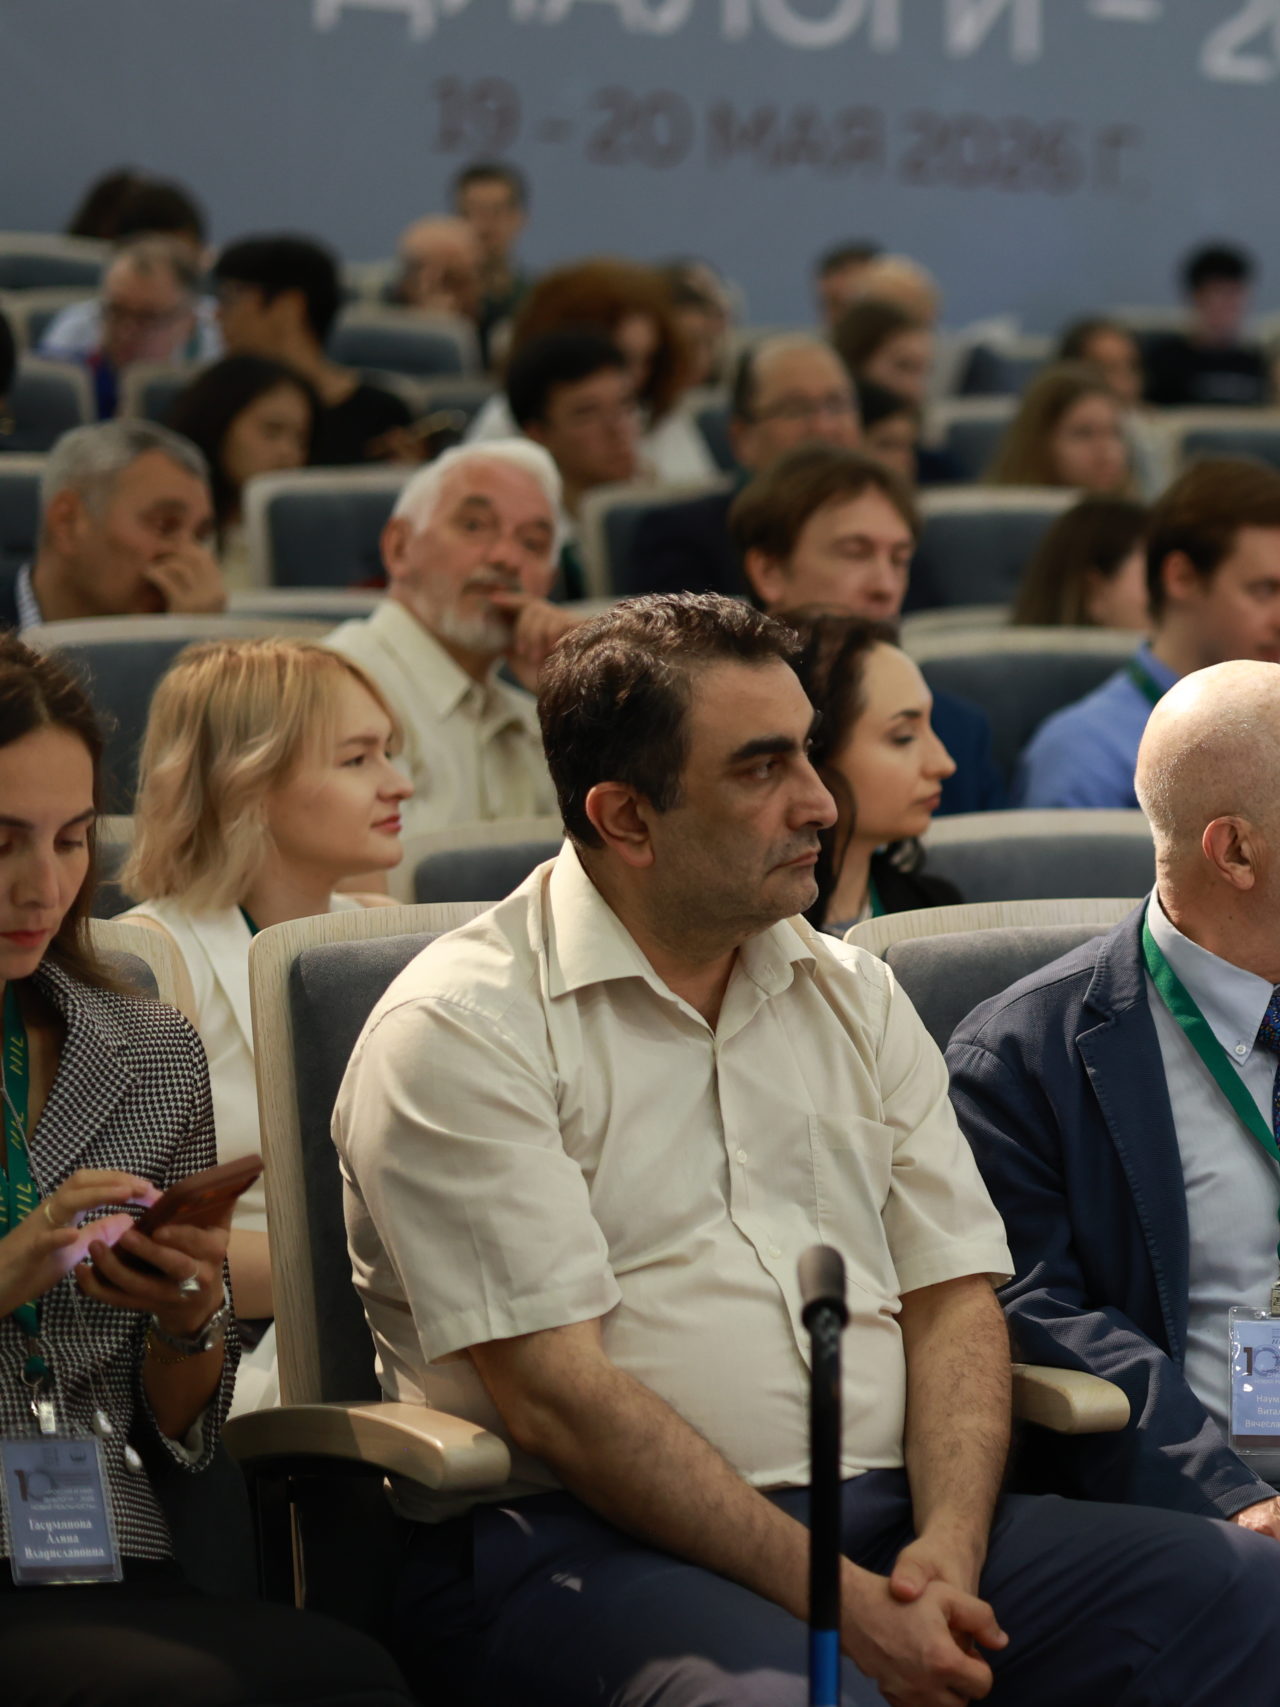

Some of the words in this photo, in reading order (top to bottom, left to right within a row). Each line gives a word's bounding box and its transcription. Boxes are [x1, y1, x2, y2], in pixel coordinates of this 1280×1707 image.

[432, 74, 521, 156] 19
[584, 86, 696, 168] 20
[704, 97, 888, 178] МАЯ
[899, 107, 1088, 195] 2026
